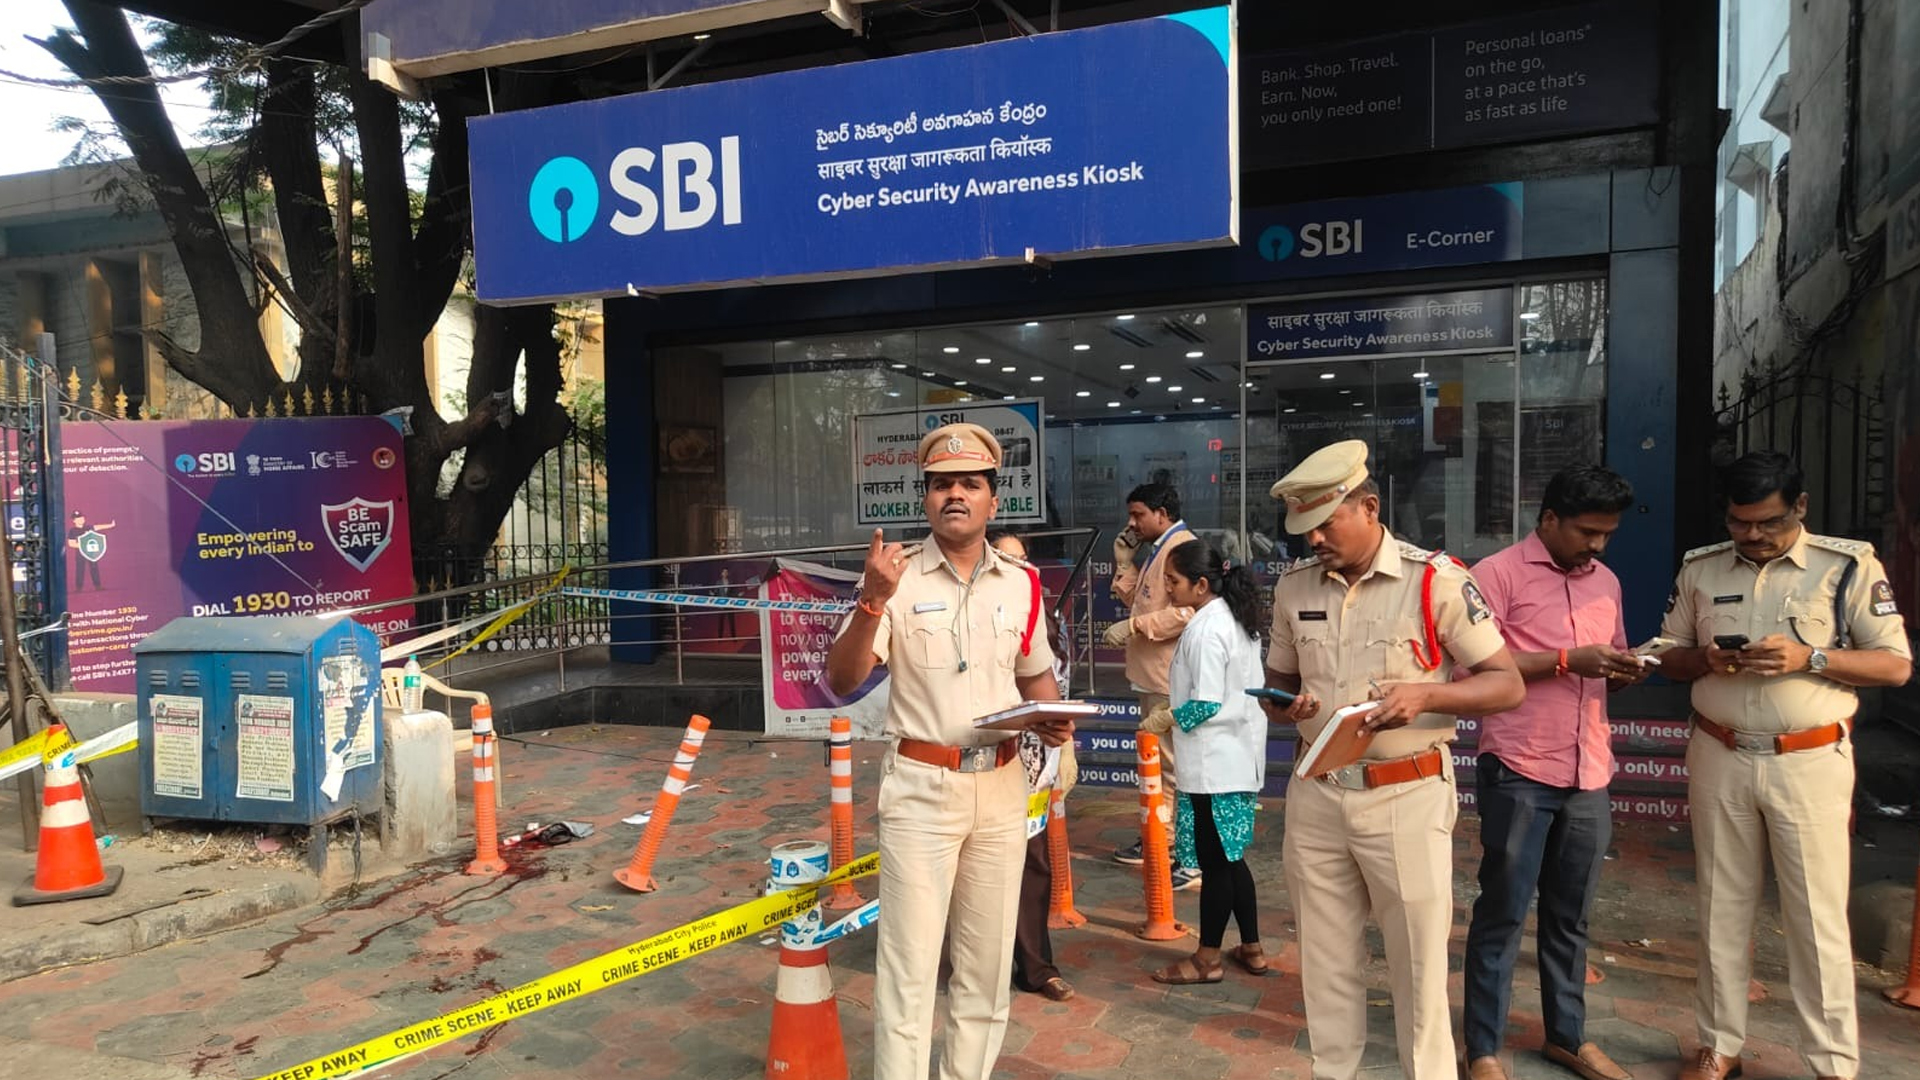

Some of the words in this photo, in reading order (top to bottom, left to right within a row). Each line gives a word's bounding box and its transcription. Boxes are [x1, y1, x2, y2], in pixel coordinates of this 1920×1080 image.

[1465, 33, 1536, 56] Personal
[1262, 69, 1298, 85] Bank.
[1304, 62, 1346, 80] Shop.
[1350, 53, 1399, 73] Travel.
[1465, 64, 1484, 78] on
[1490, 58, 1516, 75] the
[1521, 57, 1545, 75] go,
[1465, 86, 1480, 100] at
[1484, 84, 1494, 97] a
[1499, 80, 1536, 98] pace
[1541, 72, 1586, 91] that's
[1260, 112, 1287, 128] you
[1291, 104, 1323, 125] only
[1327, 102, 1364, 118] need
[1368, 96, 1402, 113] one!
[1465, 108, 1481, 122] as
[1486, 102, 1516, 120] fast
[1519, 103, 1537, 117] as
[1541, 97, 1568, 114] life
[816, 122, 850, 151] సైబర్
[922, 108, 995, 131] అవగాహన
[999, 101, 1047, 126] కేంద్రం
[817, 158, 864, 180] साइबर
[867, 151, 907, 180] सुरक्षा
[911, 143, 986, 171] जागरूकता
[990, 134, 1053, 160] कियॉस्क
[609, 135, 742, 236] SBI
[817, 191, 875, 216] Cyber
[878, 181, 961, 206] Security
[964, 170, 1079, 199] Awareness
[1083, 161, 1145, 185] Kiosk
[1300, 219, 1363, 258] SBI
[1407, 228, 1496, 249] E-Corner
[1267, 312, 1311, 330] साइबर
[1314, 310, 1350, 331] सुरक्षा
[1354, 304, 1423, 325] जागरूकता
[1257, 338, 1299, 356] Cyber
[1302, 332, 1363, 351] Security
[1366, 327, 1448, 346] Awareness
[1450, 325, 1494, 341] Kiosk
[198, 452, 236, 473] SBI
[347, 507, 370, 521] BE
[865, 501, 910, 518] LOCKER
[197, 528, 297, 546] Empowering
[339, 521, 381, 534] Scam
[199, 545, 244, 559] every
[248, 541, 295, 555] Indian
[297, 540, 314, 551] to
[339, 532, 381, 548] SAFE
[193, 604, 231, 617] DIAL
[232, 591, 290, 613] 1930
[292, 594, 314, 607] TO
[315, 588, 371, 605] REPORT
[125, 614, 149, 623] Cyber
[388, 619, 409, 632] ON
[780, 612, 795, 626] to
[799, 613, 840, 630] every
[781, 651, 829, 668] power
[782, 669, 823, 685] every
[1101, 704, 1126, 716] you
[1609, 721, 1646, 738] only
[1092, 737, 1118, 750] you
[1081, 769, 1108, 784] you
[1624, 760, 1665, 777] only
[1635, 799, 1677, 818] only
[602, 961, 640, 983] CRIME
[643, 947, 680, 970] SCENE
[688, 933, 717, 954] KEEP
[720, 923, 748, 942] AWAY
[763, 906, 793, 926] CRIME
[628, 934, 674, 955] Hyderabad
[674, 929, 691, 941] City
[691, 920, 718, 933] Police
[320, 1048, 367, 1074] AWAY
[394, 1023, 445, 1050] CRIME
[449, 1007, 496, 1033] SCENE
[507, 992, 542, 1014] KEEP
[546, 979, 582, 1001] AWAY
